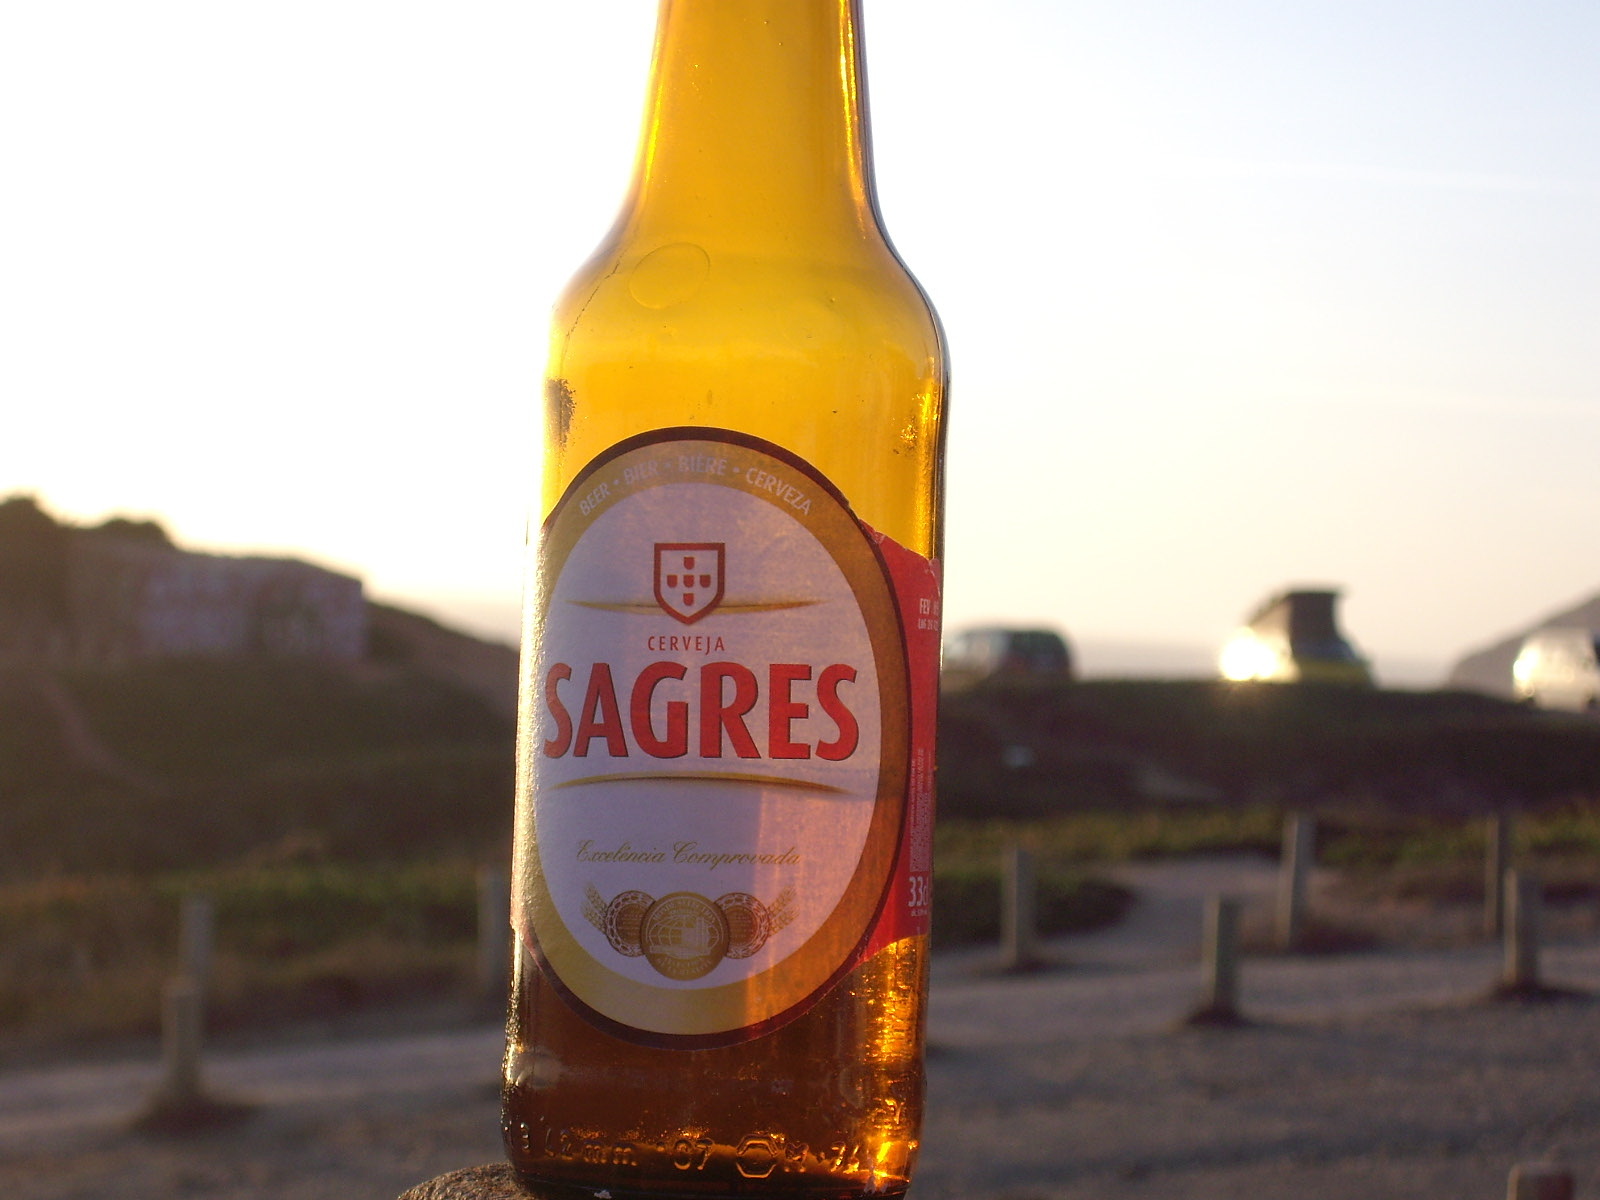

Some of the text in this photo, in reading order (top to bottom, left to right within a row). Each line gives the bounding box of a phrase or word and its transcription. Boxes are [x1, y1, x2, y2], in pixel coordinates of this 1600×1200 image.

[579, 482, 611, 516] BEER
[623, 460, 658, 485] BIER
[745, 467, 813, 516] CERVEZA
[647, 635, 725, 655] CERVEJA
[542, 661, 859, 761] SAGRES
[673, 840, 801, 871] Comprovada
